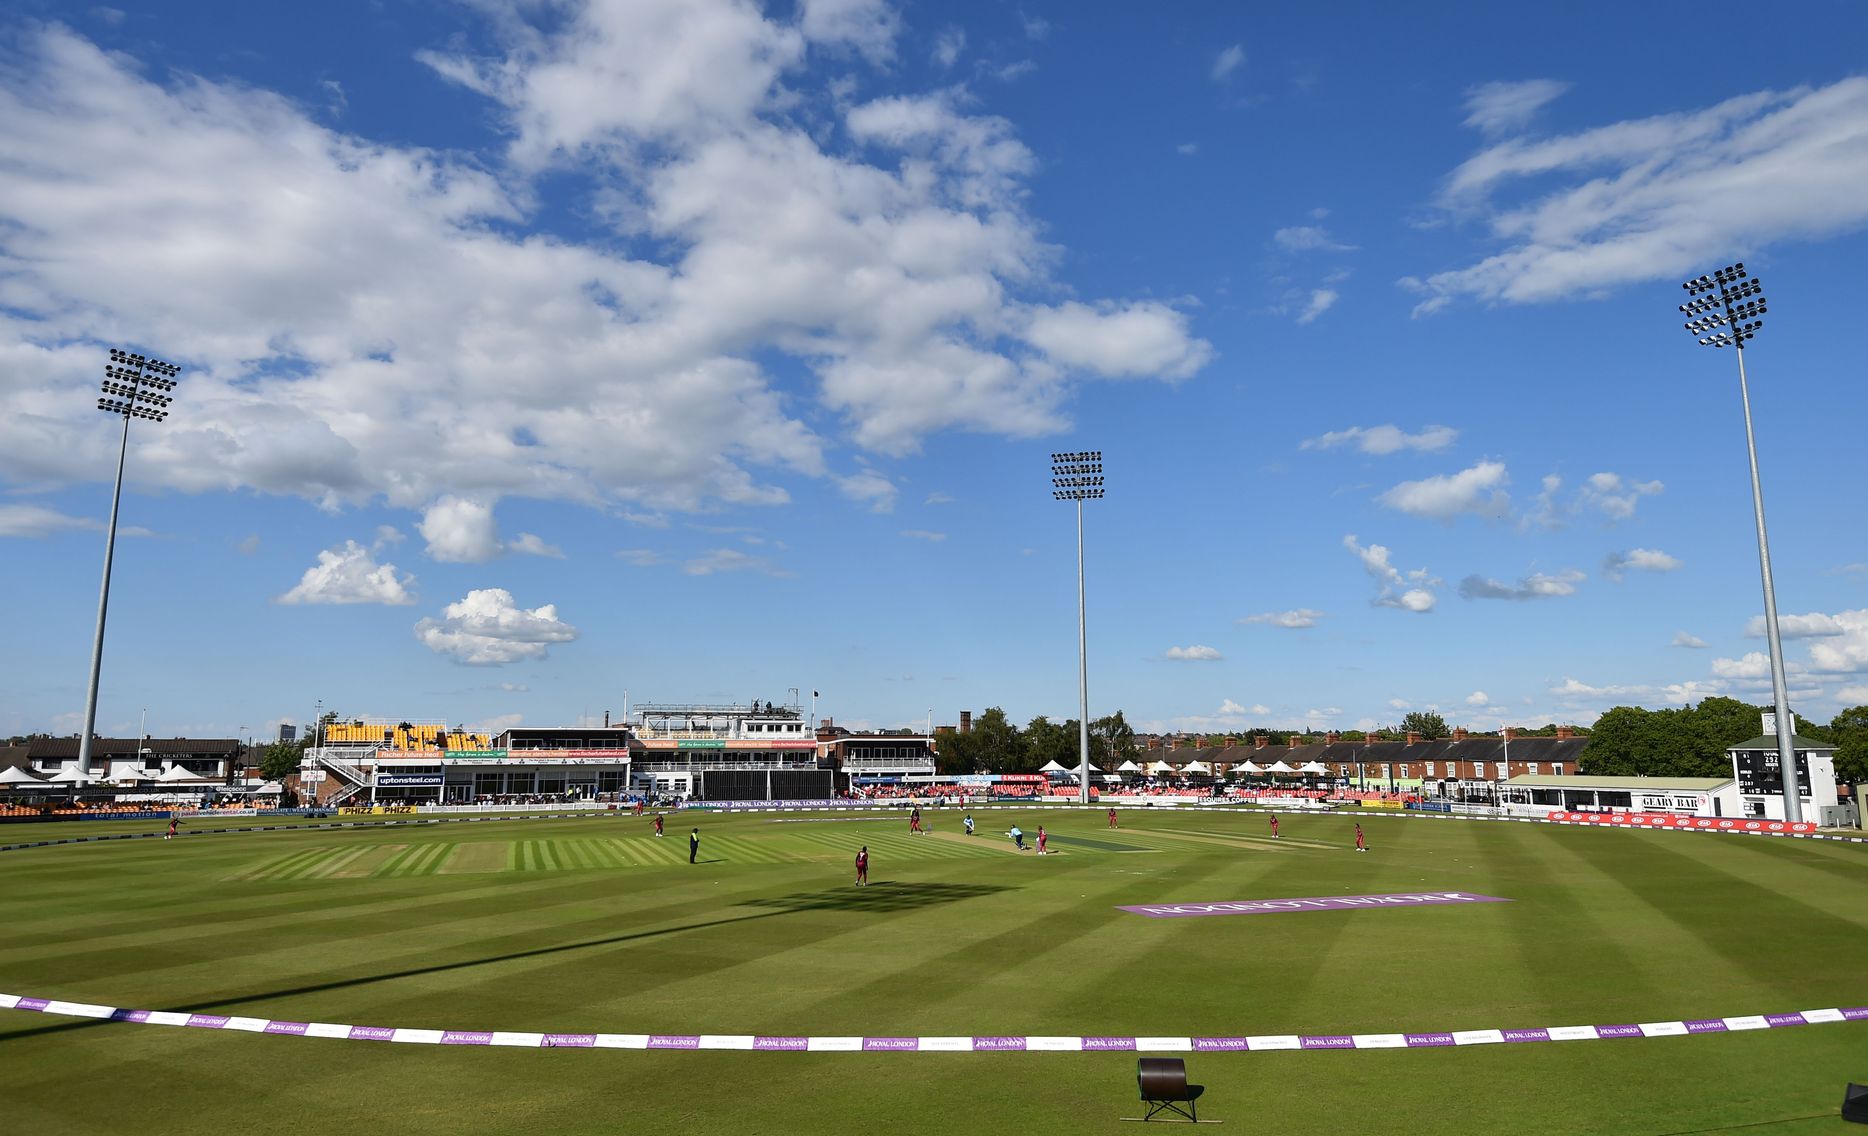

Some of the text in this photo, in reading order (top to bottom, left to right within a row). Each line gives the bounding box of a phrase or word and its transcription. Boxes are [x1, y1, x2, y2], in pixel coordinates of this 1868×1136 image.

[380, 777, 441, 785] uptonsteel.com
[784, 800, 803, 808] ROYAL
[1643, 798, 1698, 807] GEARY BAR
[1616, 1026, 1640, 1034] LONDON
